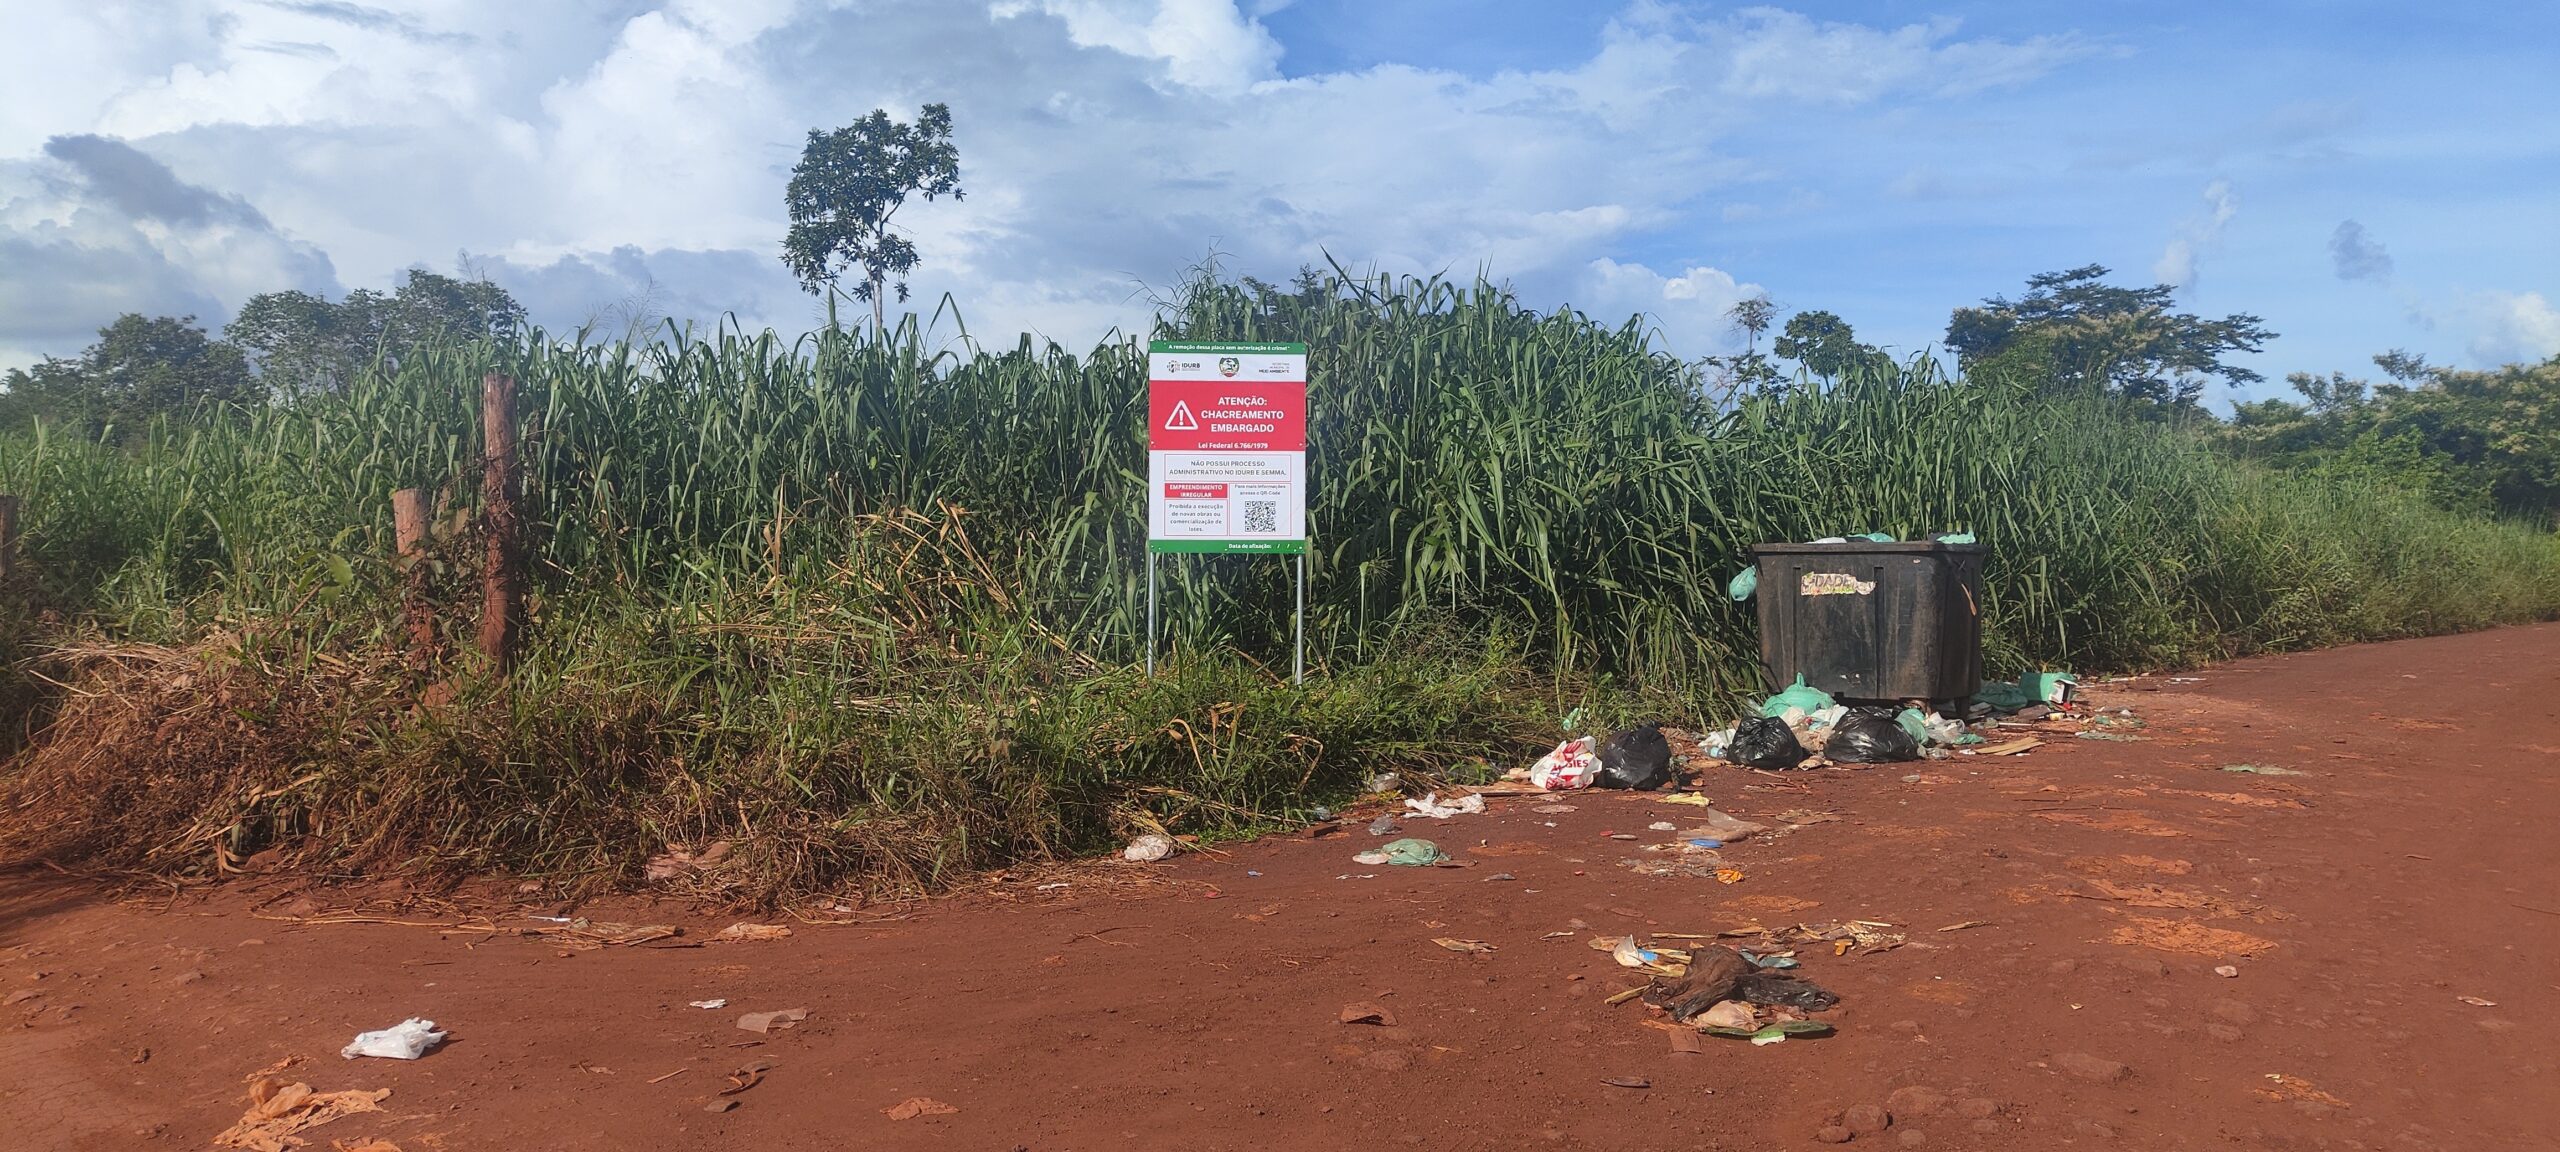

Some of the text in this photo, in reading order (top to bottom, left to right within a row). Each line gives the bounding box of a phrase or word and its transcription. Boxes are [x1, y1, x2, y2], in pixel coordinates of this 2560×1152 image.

[1217, 395, 1268, 408] ATENÇÃO:
[1200, 410, 1285, 420] CHACREAMENTO
[1210, 423, 1275, 433] EMBARGADO
[1190, 459, 1204, 467] NÃO
